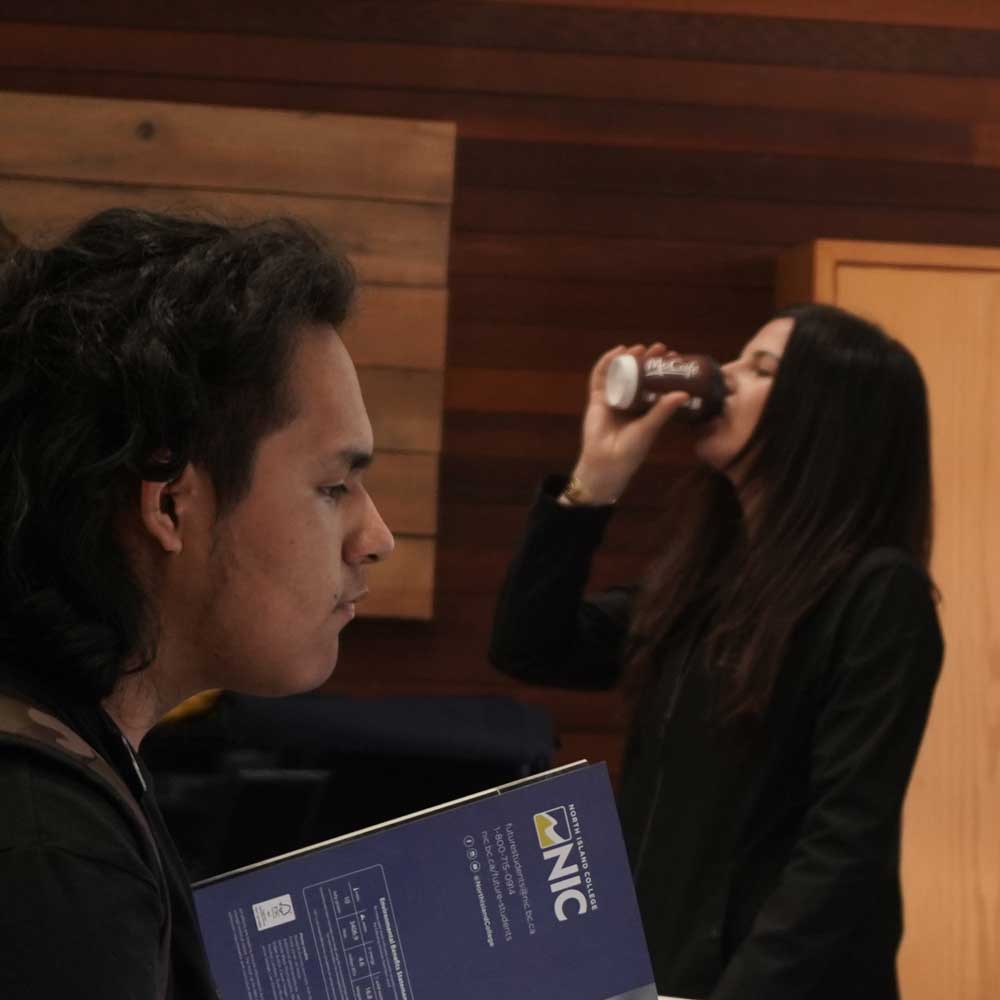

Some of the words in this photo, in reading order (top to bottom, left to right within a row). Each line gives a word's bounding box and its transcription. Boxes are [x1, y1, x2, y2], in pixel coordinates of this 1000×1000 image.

[480, 830, 514, 942] nic.bc.ca/future-students
[504, 823, 537, 935] futurestudents@nic.bc.ca
[543, 844, 588, 922] NIC
[568, 804, 582, 834] NORTH
[575, 836, 590, 870] ISLAND
[583, 871, 598, 911] COLLEGE
[379, 897, 396, 944] Environmental
[390, 943, 402, 971] Benefits
